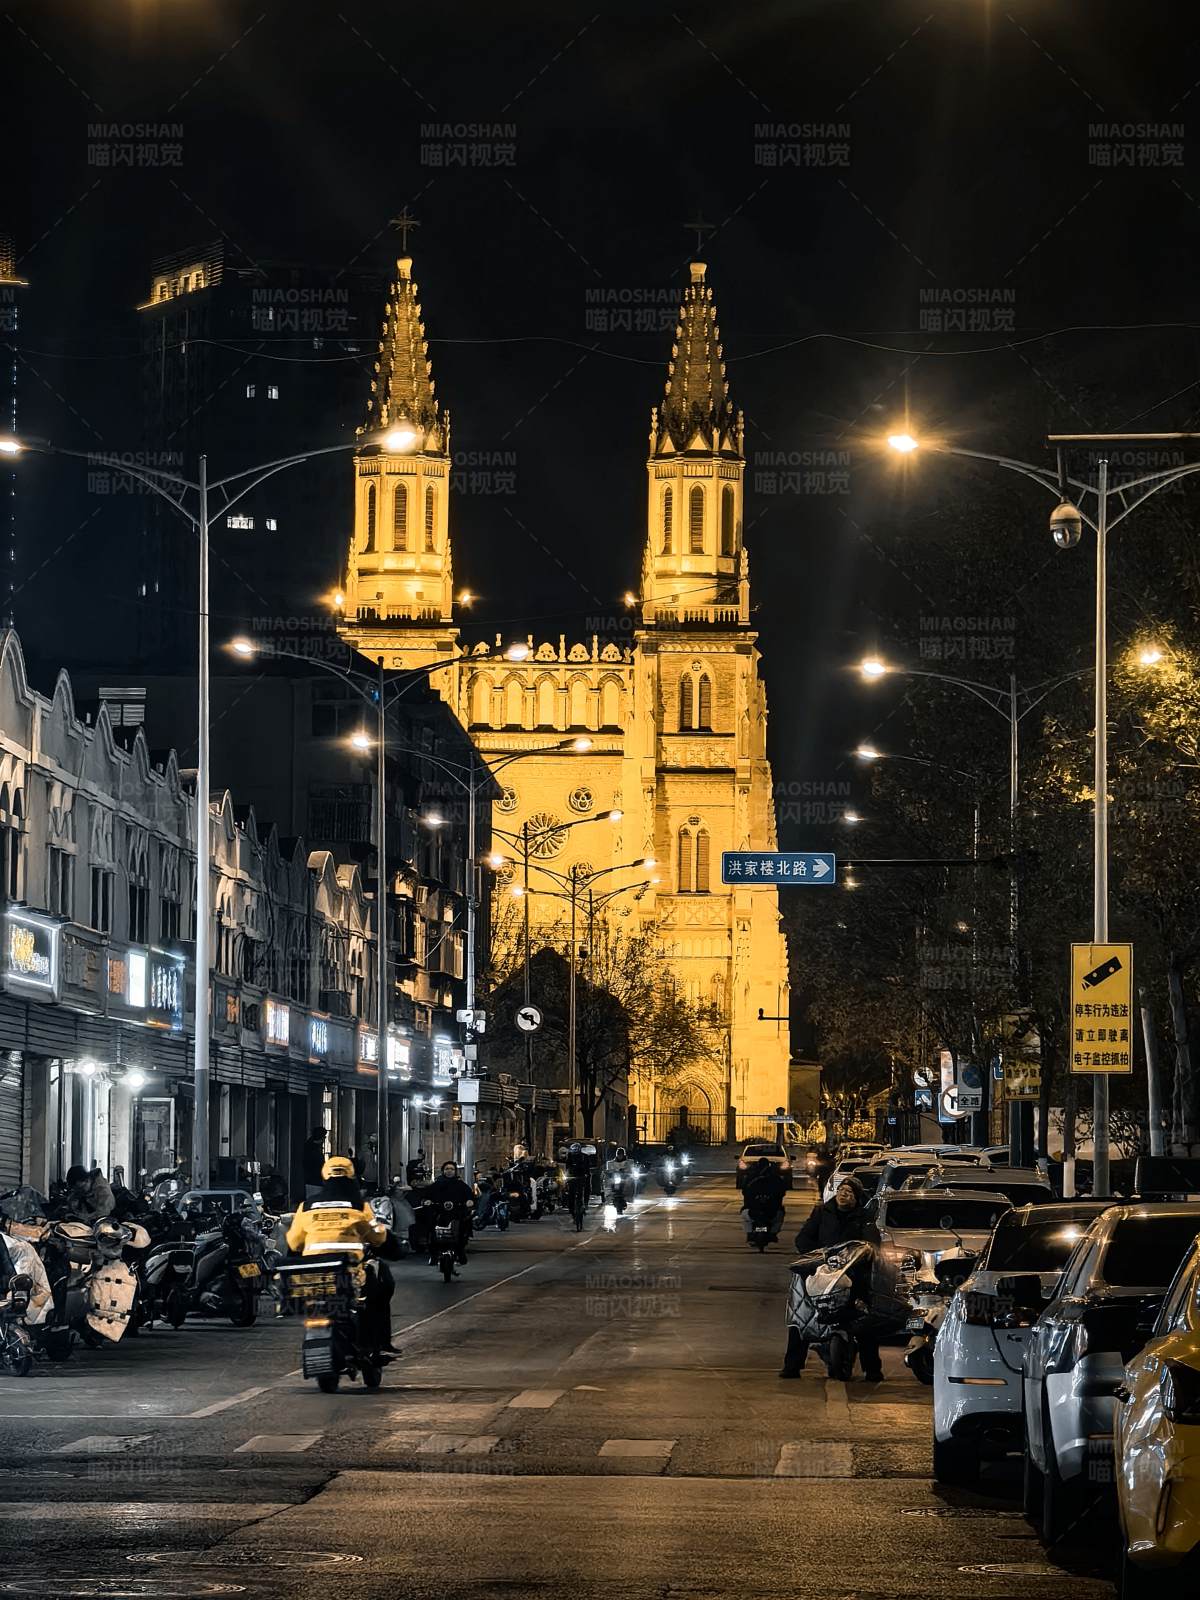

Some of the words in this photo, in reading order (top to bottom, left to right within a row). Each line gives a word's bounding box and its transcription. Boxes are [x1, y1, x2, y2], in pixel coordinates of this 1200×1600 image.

[728, 860, 807, 876] 洪家楼北路
[1075, 1003, 1129, 1018] 停车行为违法
[1075, 1028, 1129, 1043] 请立即驶离
[1074, 1051, 1129, 1066] 电子监控抓拍
